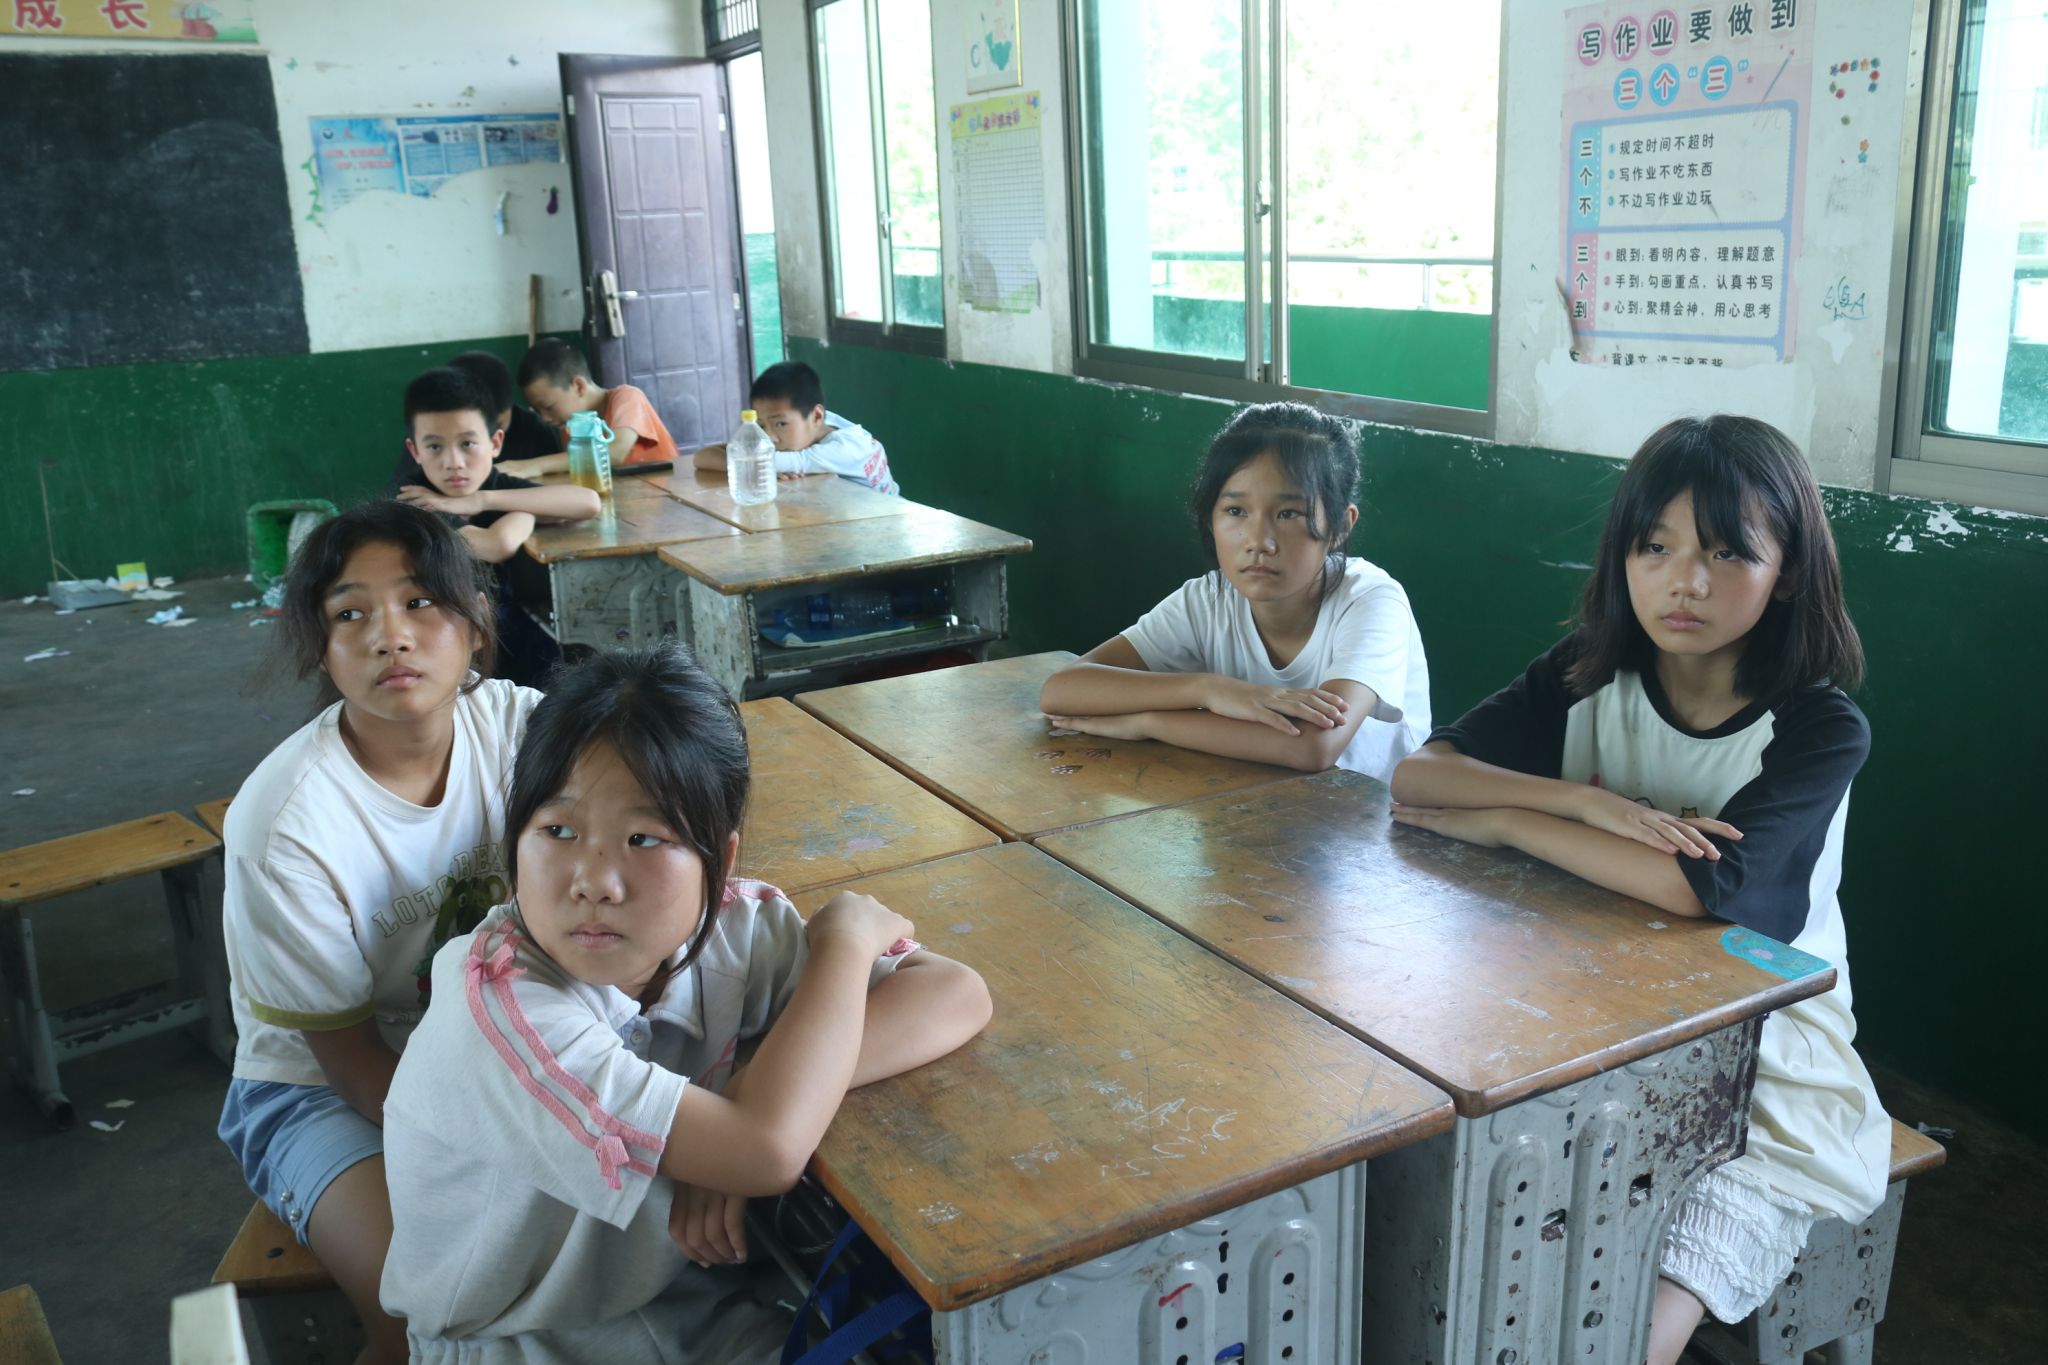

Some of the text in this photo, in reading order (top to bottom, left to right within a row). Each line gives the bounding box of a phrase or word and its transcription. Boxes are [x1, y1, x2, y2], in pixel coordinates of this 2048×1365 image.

[15, 0, 147, 30] 成长
[1580, 0, 1797, 59] 写作业要做到
[1619, 132, 1714, 155] 规定时间不超时
[1579, 140, 1593, 215] 三个不
[1619, 161, 1713, 182] 写作业不吃东西
[1618, 189, 1712, 208] 不边写作业边玩
[1573, 246, 1589, 319] 三个到
